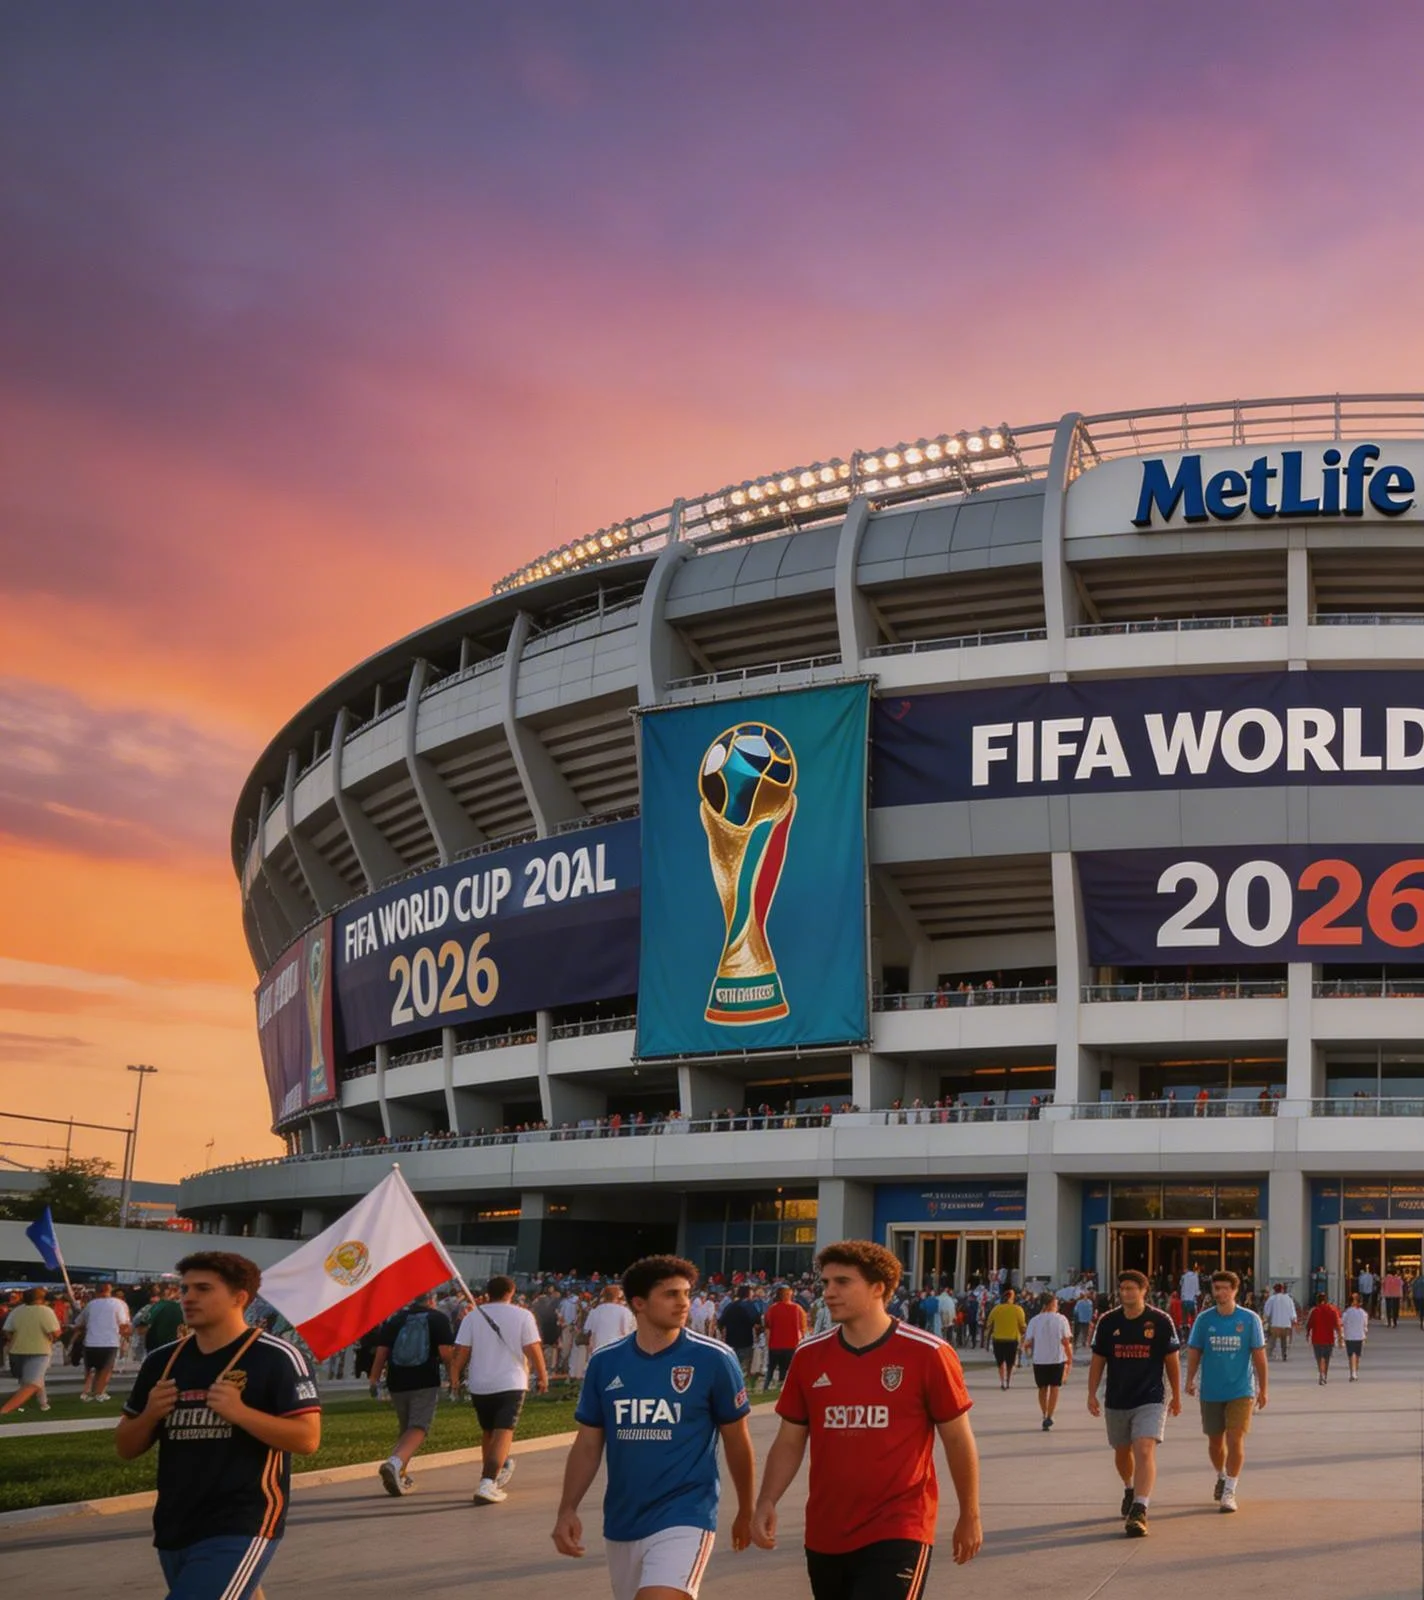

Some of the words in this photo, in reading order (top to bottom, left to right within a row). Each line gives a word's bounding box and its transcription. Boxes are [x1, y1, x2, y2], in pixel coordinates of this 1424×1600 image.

[1130, 444, 1416, 527] MetLife
[972, 715, 1132, 787] FIFA
[344, 911, 379, 964] FIFA
[378, 884, 450, 947] WORLD
[453, 867, 512, 923] CUP
[388, 932, 500, 1027] 2026
